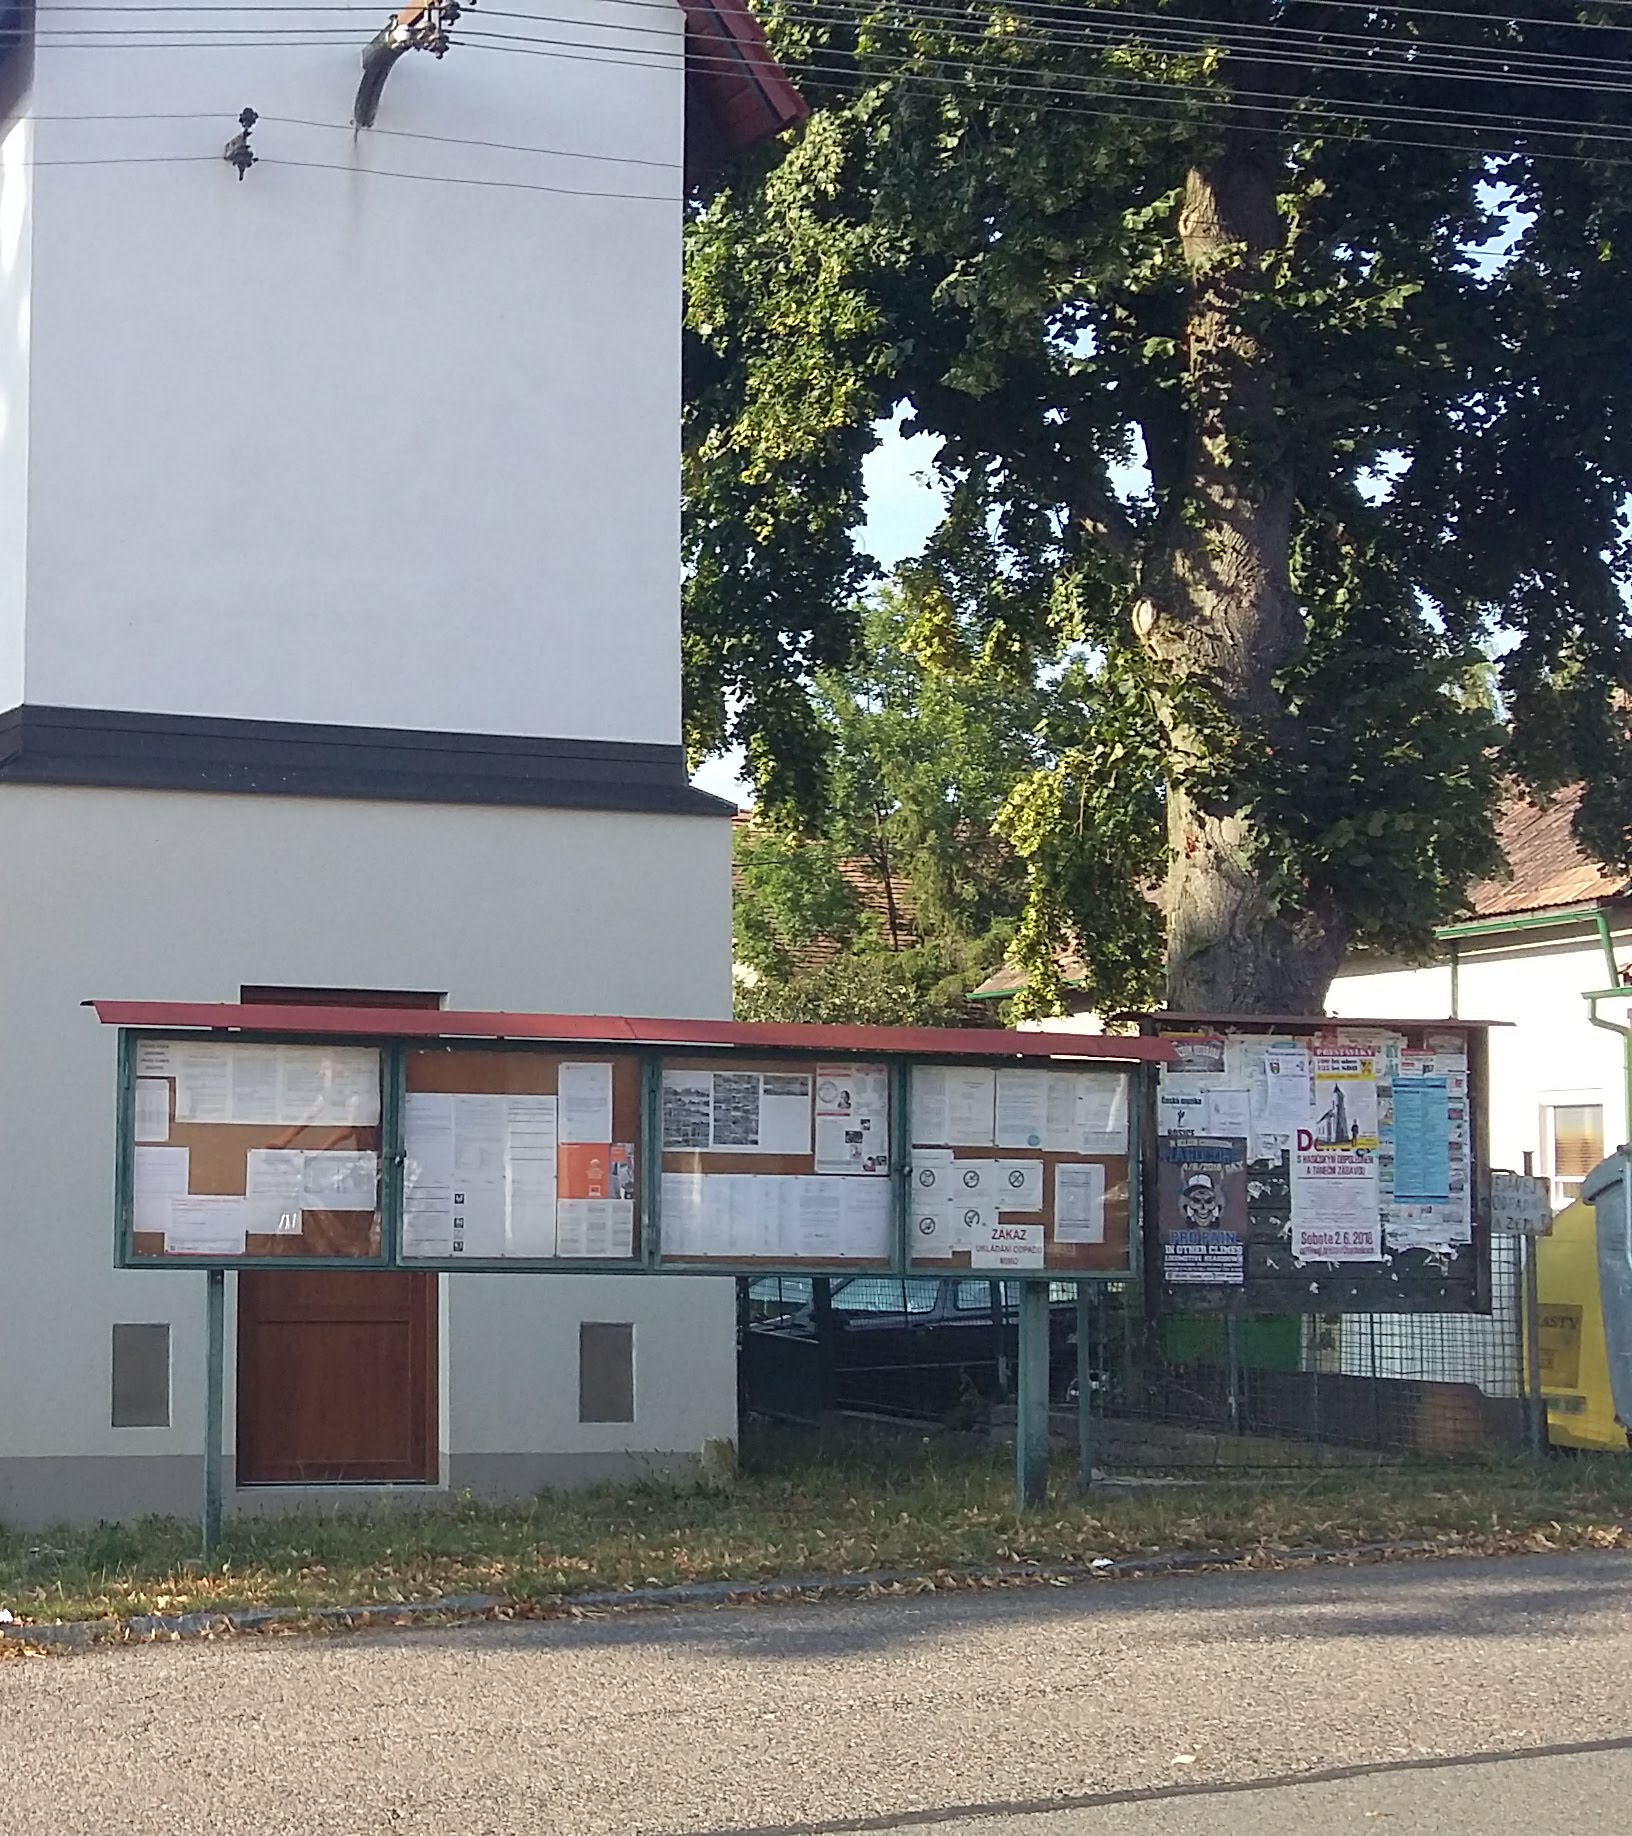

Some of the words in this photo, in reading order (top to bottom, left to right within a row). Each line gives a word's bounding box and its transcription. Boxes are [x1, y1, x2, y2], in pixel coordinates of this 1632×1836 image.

[991, 1227, 1027, 1240] ZÁKAZ
[1176, 1245, 1207, 1254] OTHER
[1209, 1245, 1243, 1254] CLIMES
